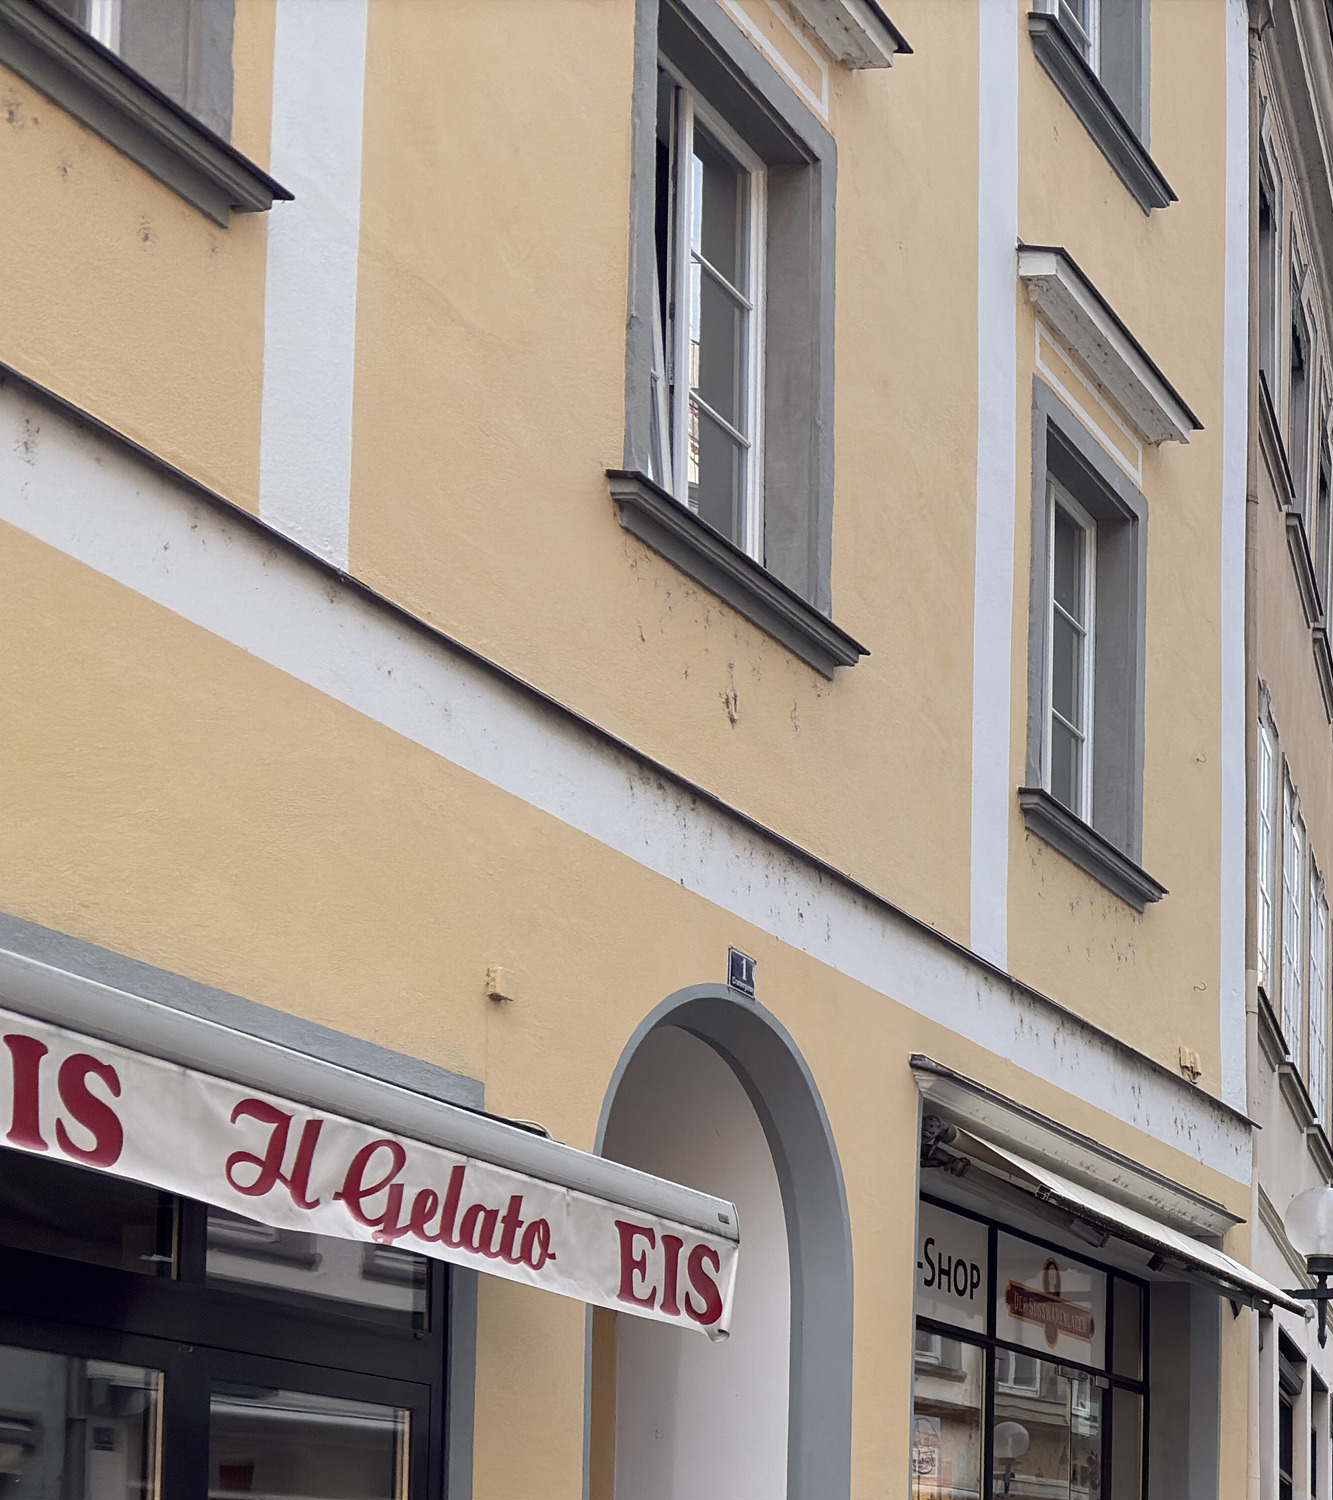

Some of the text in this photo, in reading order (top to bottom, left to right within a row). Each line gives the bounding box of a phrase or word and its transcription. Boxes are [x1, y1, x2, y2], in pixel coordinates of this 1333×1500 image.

[741, 957, 748, 981] 1
[3, 1034, 124, 1168] IS
[332, 1139, 557, 1271] Gelato
[614, 1219, 723, 1326] EIS
